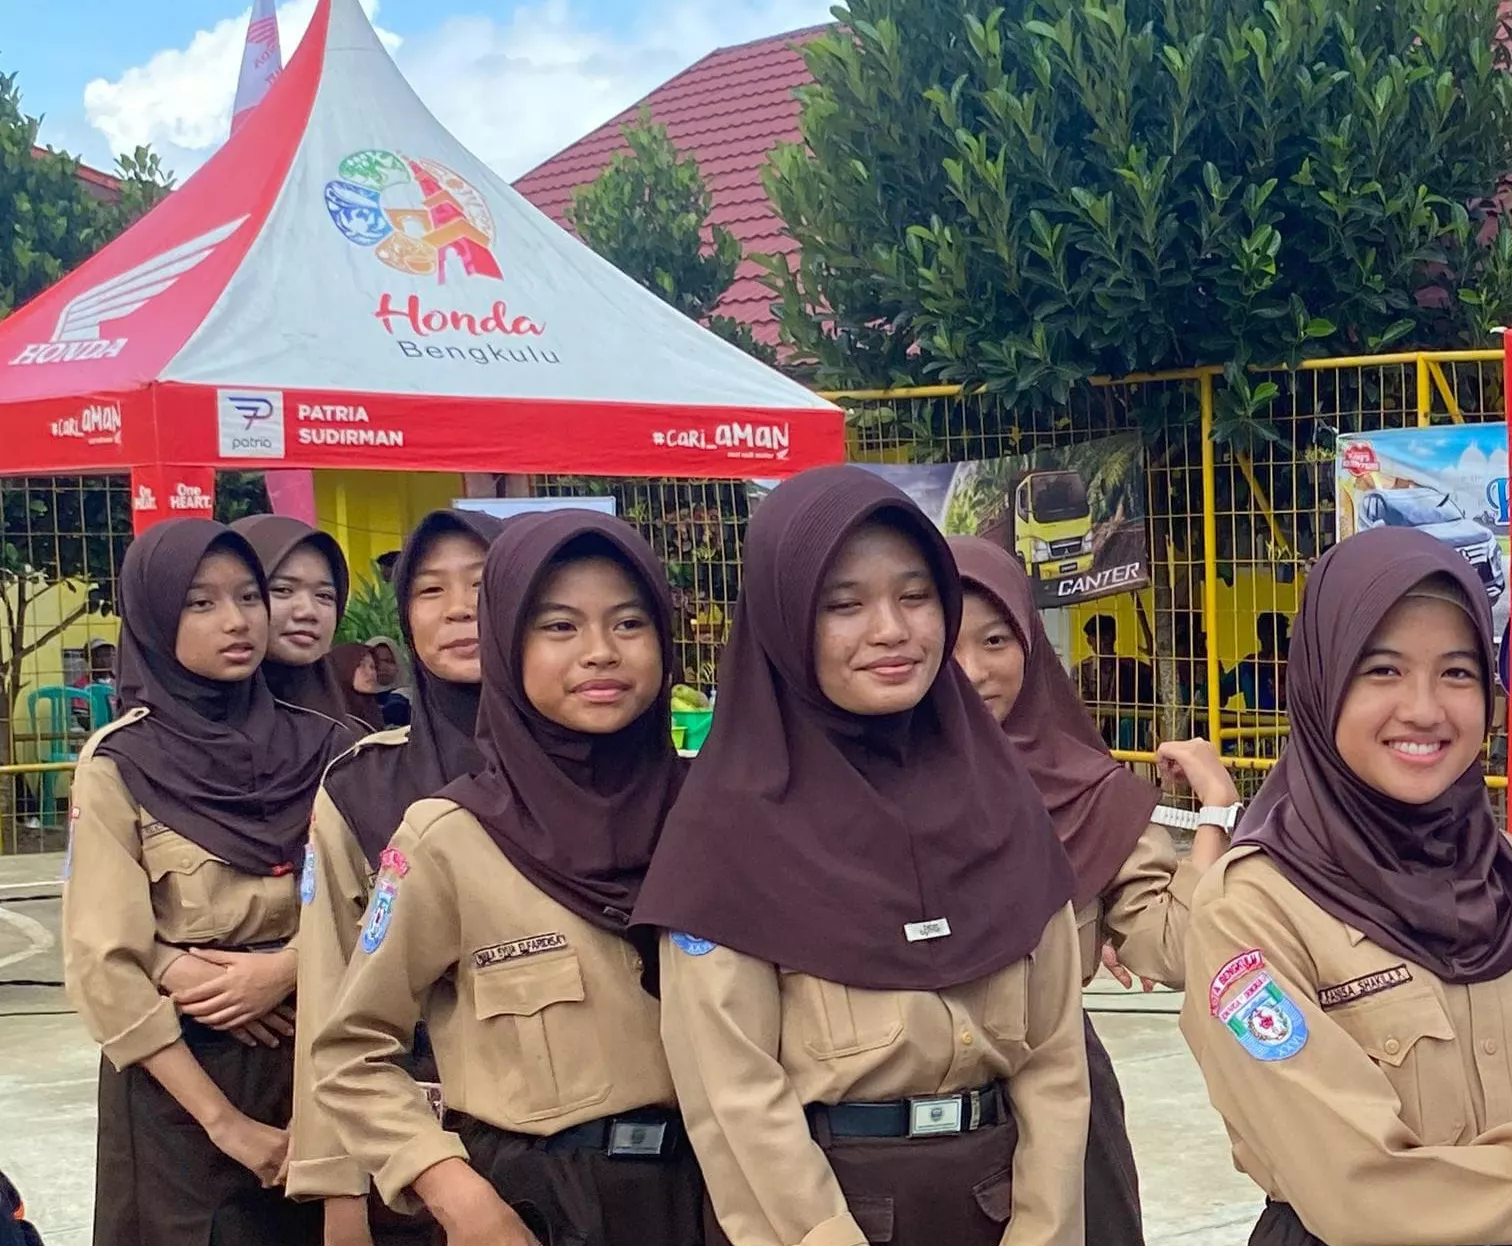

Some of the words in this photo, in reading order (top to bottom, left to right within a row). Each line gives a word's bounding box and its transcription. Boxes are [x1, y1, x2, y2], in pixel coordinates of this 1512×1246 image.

[374, 292, 546, 337] Honda
[8, 338, 128, 365] HONDA
[397, 340, 561, 365] Bengkulu
[298, 404, 369, 423] PATRIA
[232, 436, 272, 450] patria
[298, 428, 404, 447] SUDIRMAN
[177, 482, 201, 496] One
[1057, 562, 1140, 596] CANTER
